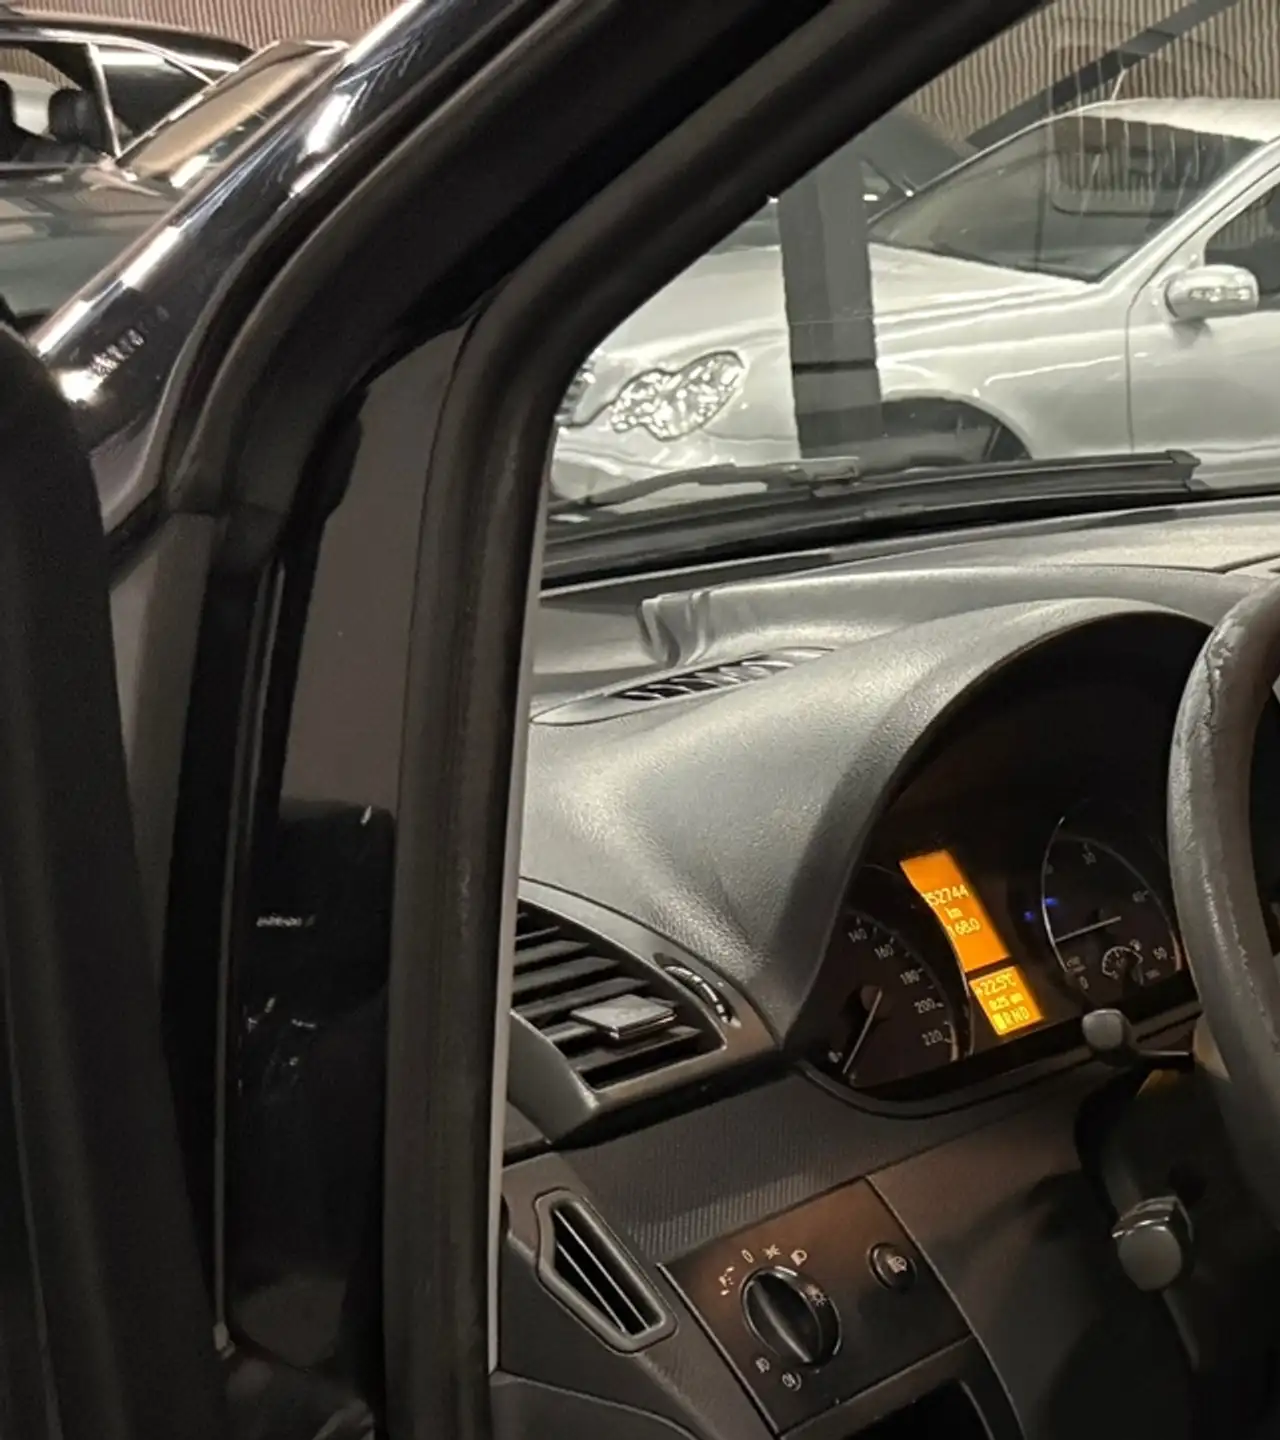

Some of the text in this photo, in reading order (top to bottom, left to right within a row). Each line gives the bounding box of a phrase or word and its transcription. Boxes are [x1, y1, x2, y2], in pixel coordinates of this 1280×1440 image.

[874, 943, 894, 960] 160
[900, 968, 920, 985] 180
[913, 998, 935, 1015] 200
[921, 1029, 943, 1047] 220
